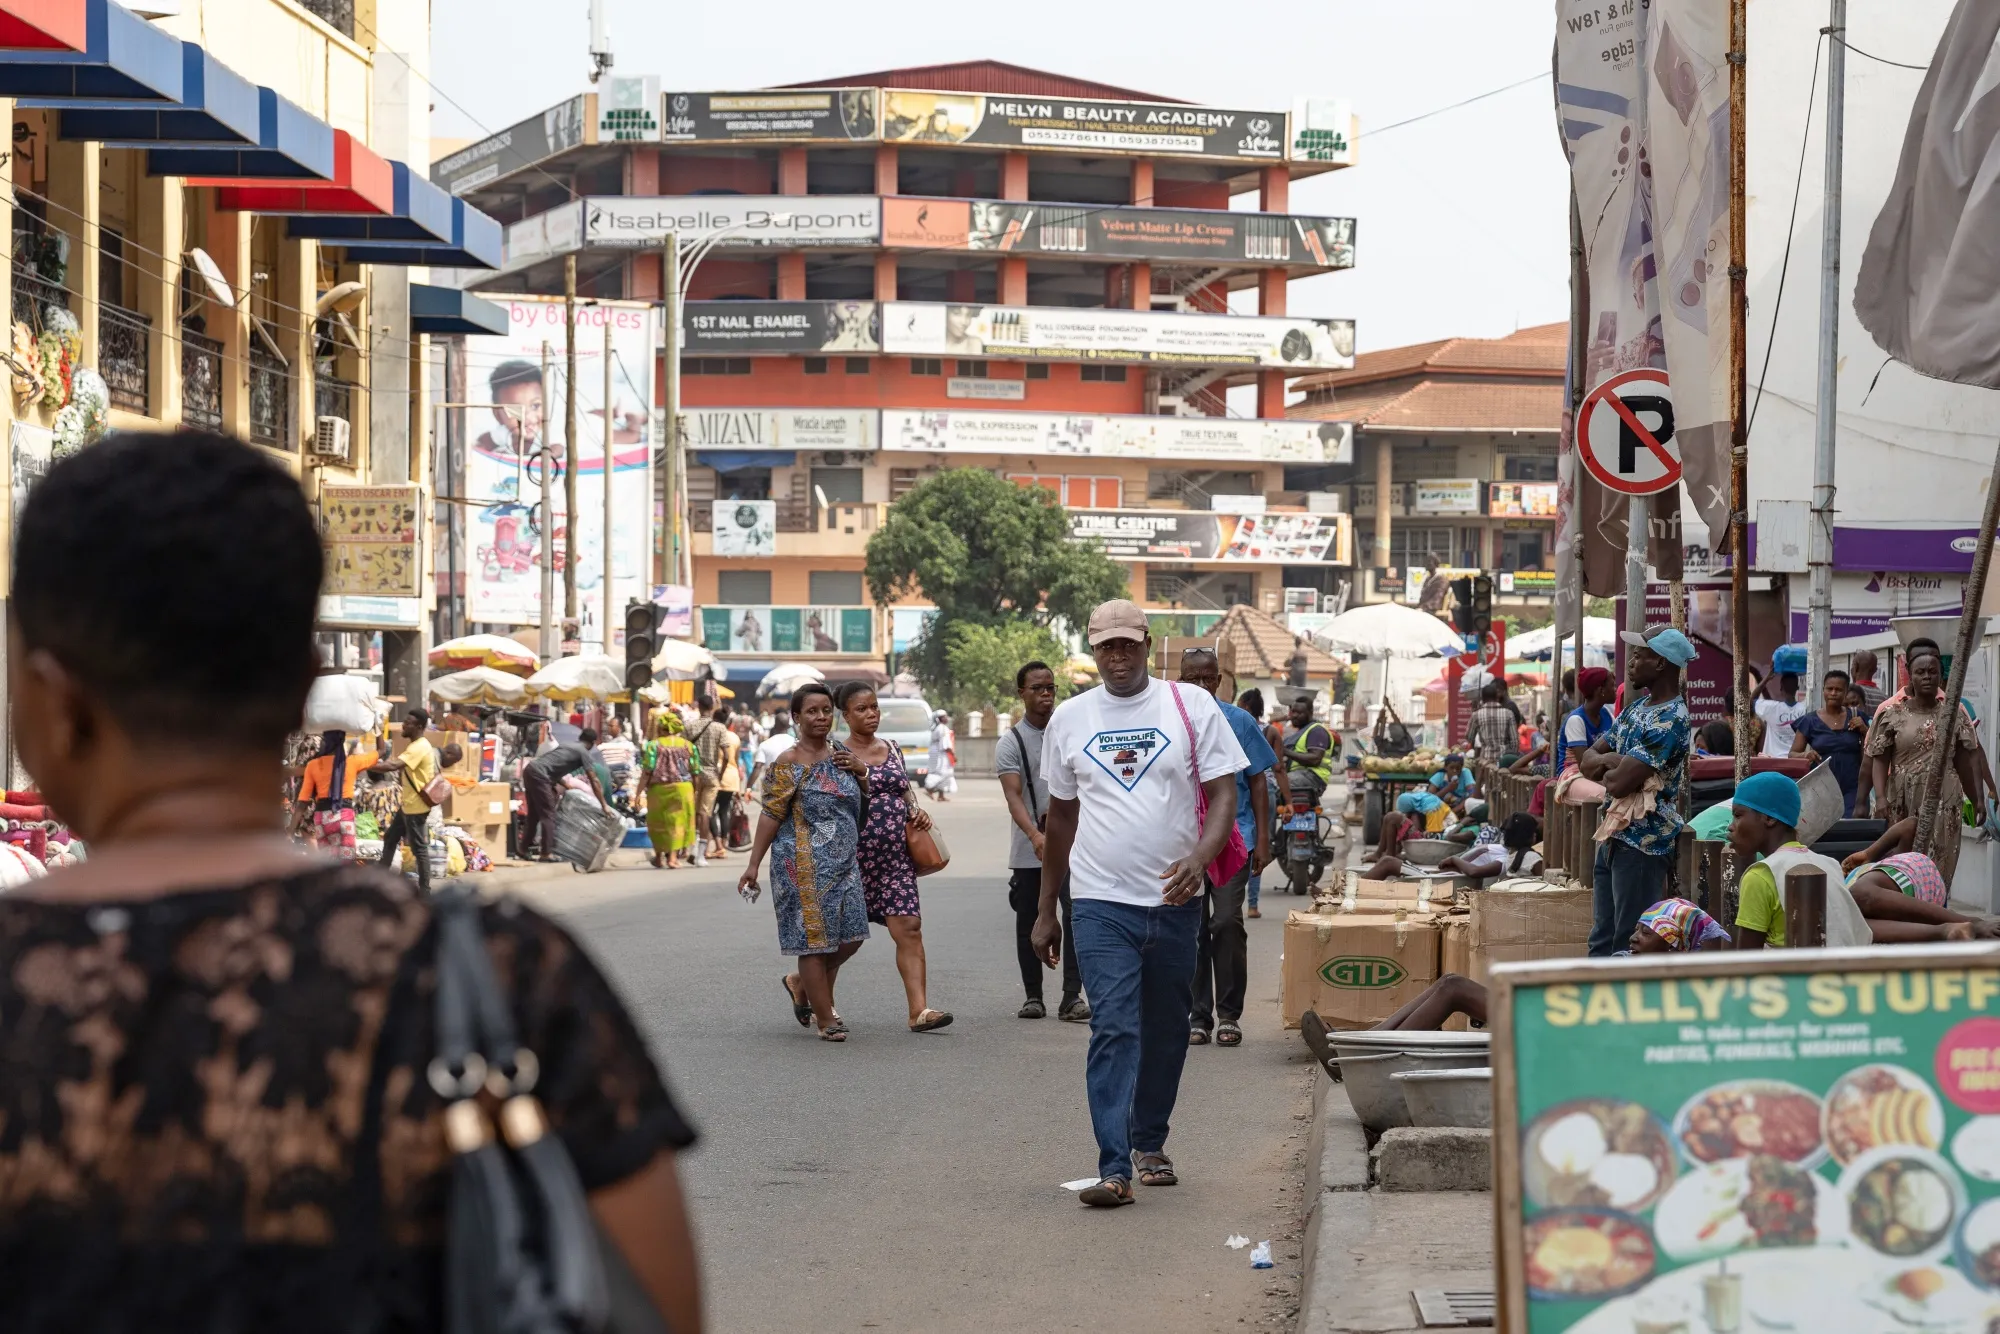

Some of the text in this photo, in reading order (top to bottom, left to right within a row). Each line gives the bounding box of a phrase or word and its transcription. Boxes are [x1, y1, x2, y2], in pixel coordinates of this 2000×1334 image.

[989, 102, 1236, 128] MELYN BEAUTY ACADEMY
[609, 210, 872, 231] Isabelle Dupont
[1100, 219, 1234, 236] Velvet Matte Lip Cream
[510, 302, 538, 328] by
[692, 314, 811, 329] 1ST NAIL ENAMEL
[699, 413, 765, 445] MIZANI
[954, 420, 1038, 431] CURL EXPRESSION
[1180, 429, 1238, 440] TRUE TEXTURE
[1619, 395, 1675, 474] P
[363, 489, 391, 498] OSCAR
[1079, 515, 1117, 529] TIME
[1117, 516, 1177, 531] CENTRE
[1655, 584, 1699, 594] PROCTS:
[1645, 605, 1671, 615] urren
[1687, 678, 1716, 689] nsfers
[1690, 711, 1723, 721] ervices
[1099, 734, 1113, 744] VOI
[1100, 744, 1137, 752] LODGE
[1329, 961, 1398, 985] GTP
[1544, 969, 2000, 1027] SALLY'S STUFF
[1746, 1023, 1795, 1040] orders
